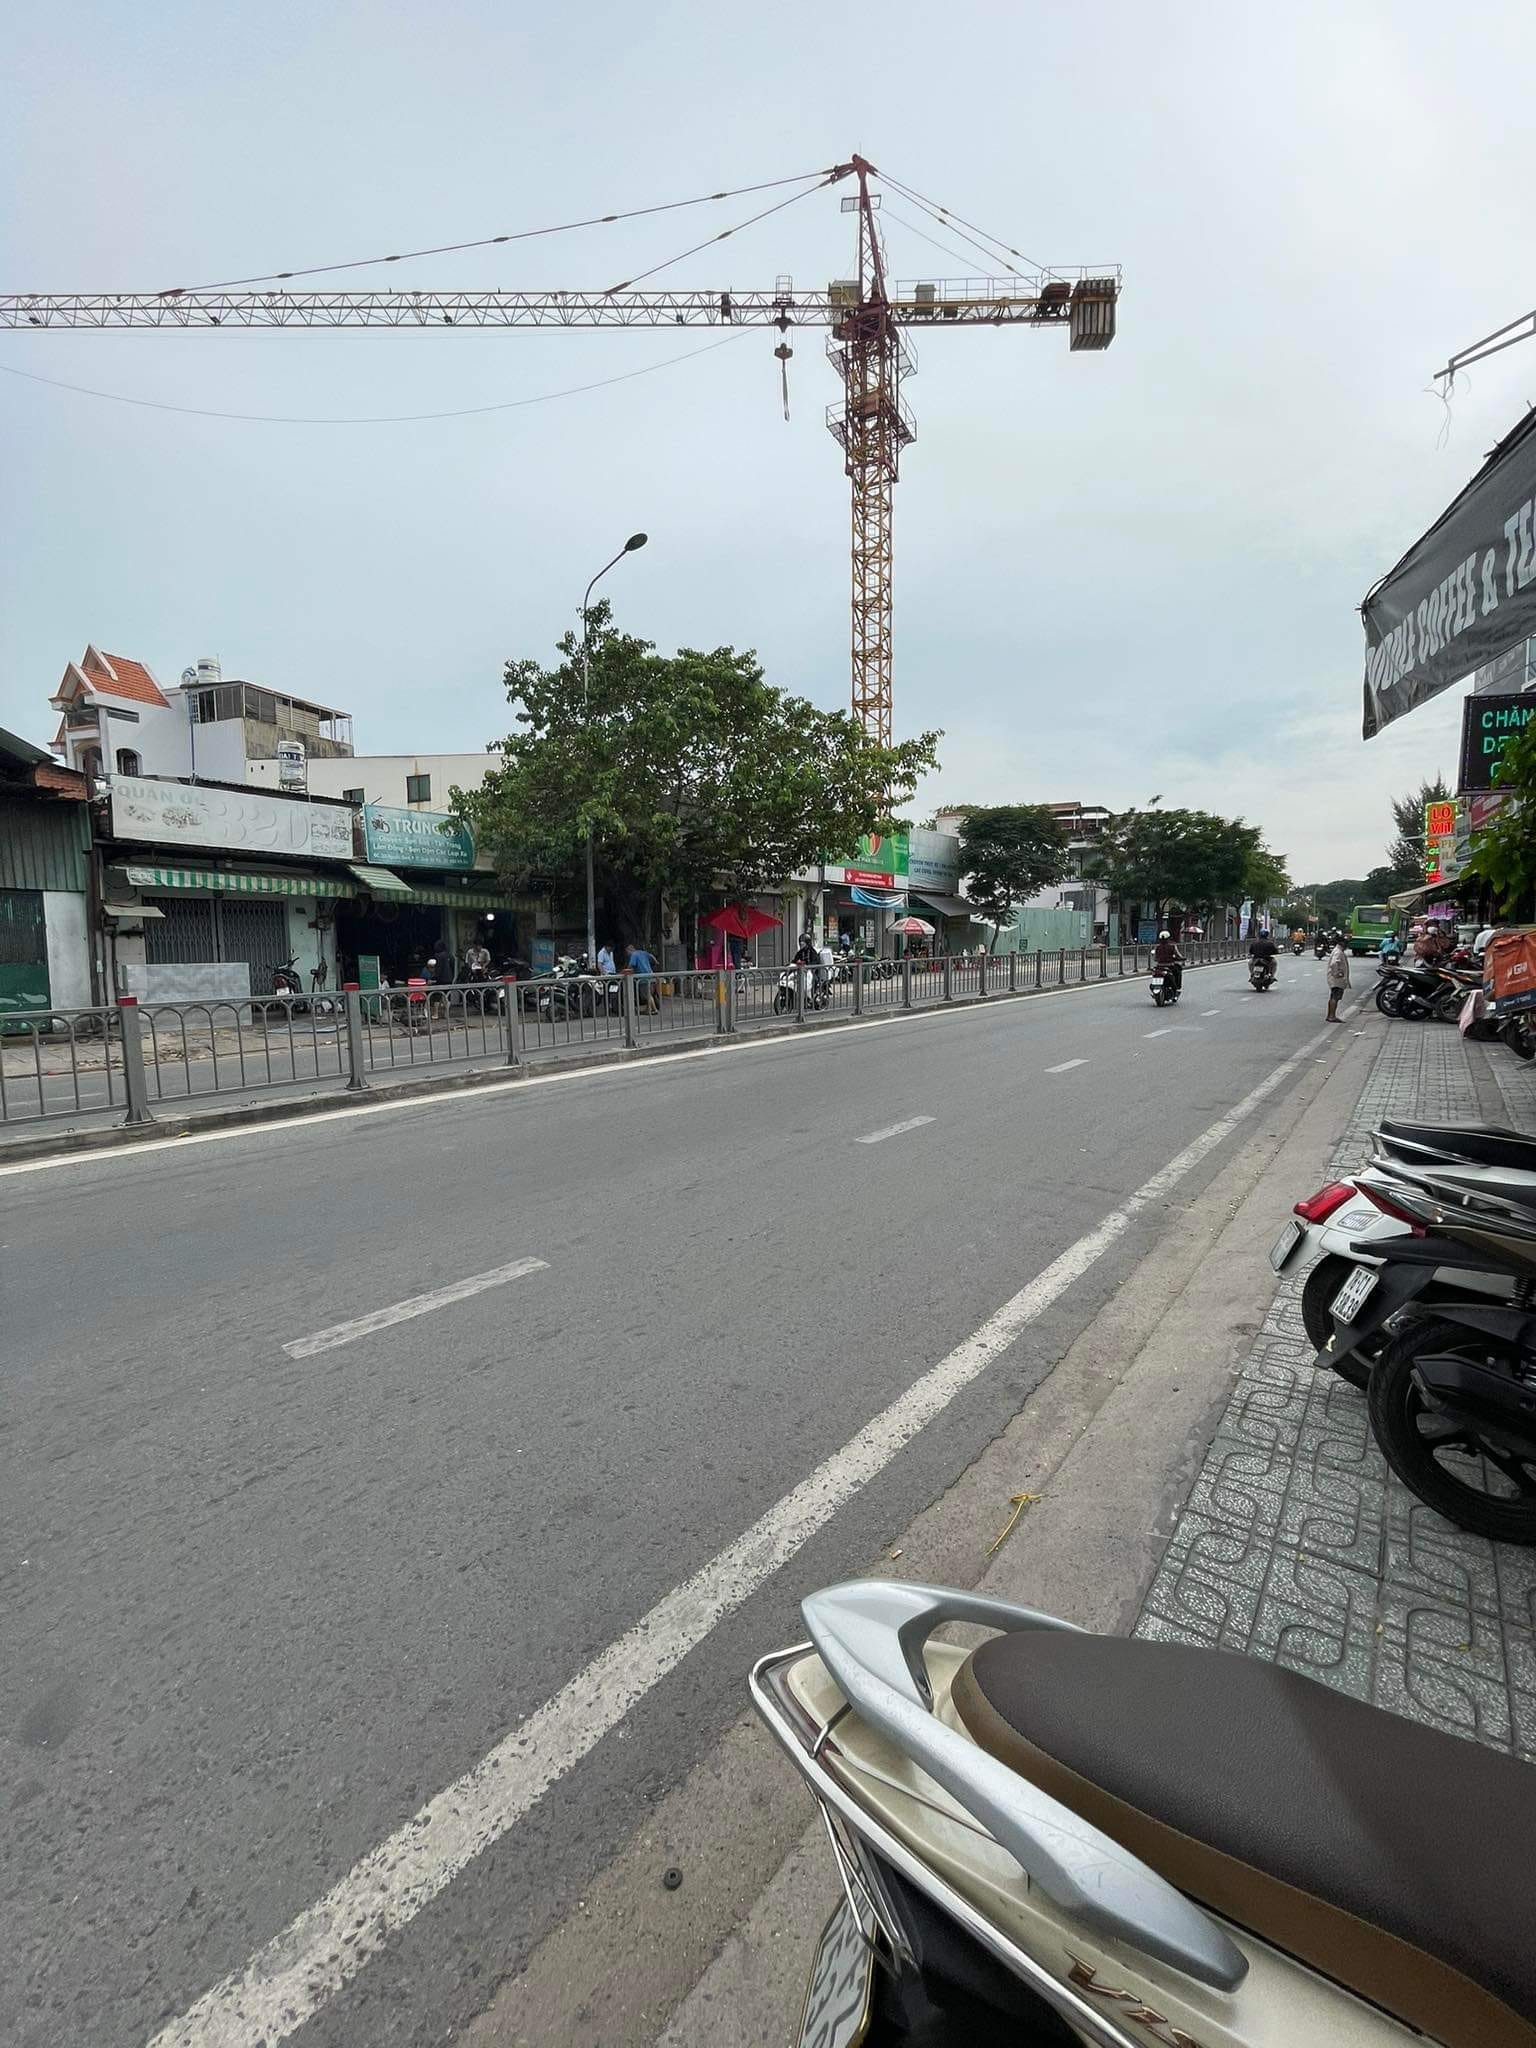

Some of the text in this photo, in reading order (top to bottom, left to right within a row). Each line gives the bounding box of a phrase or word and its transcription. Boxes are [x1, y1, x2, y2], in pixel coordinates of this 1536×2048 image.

[1417, 552, 1477, 664] COFFEE
[1481, 548, 1499, 616] &
[1504, 494, 1536, 597] TE
